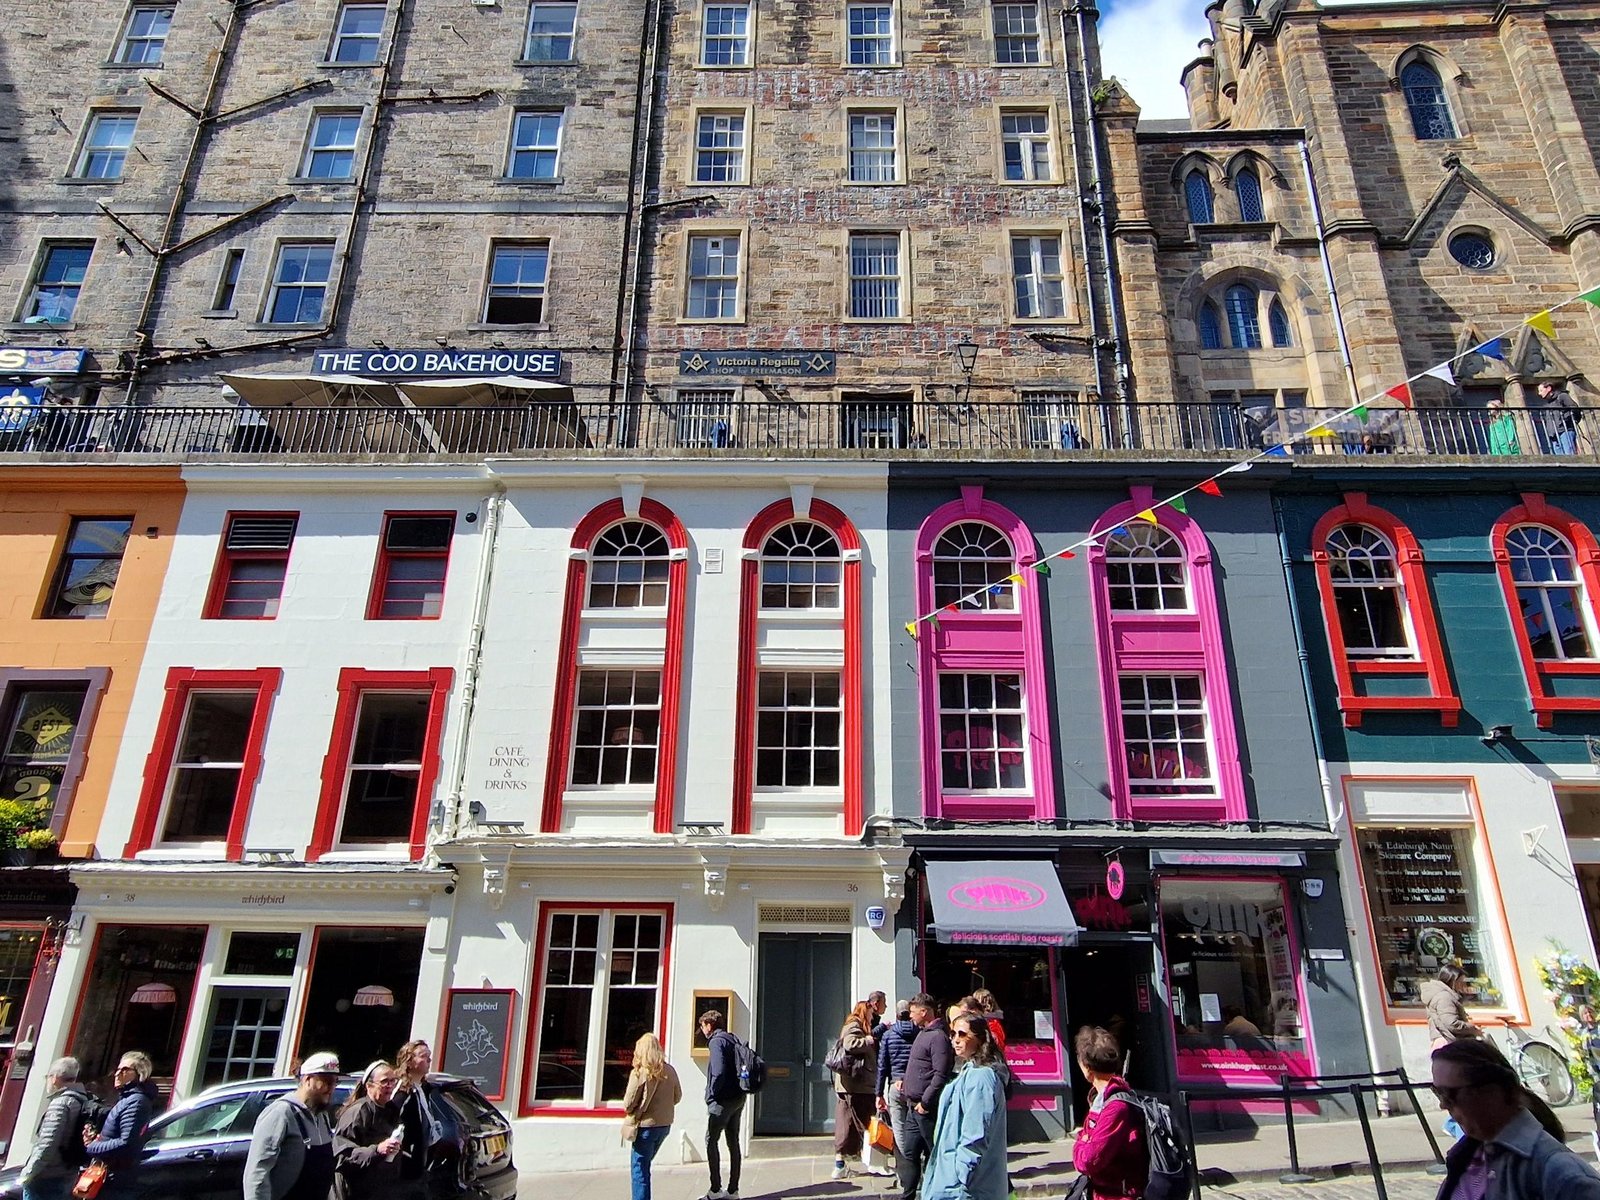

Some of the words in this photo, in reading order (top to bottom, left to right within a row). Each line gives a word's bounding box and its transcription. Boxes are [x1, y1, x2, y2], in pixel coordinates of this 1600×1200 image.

[318, 353, 362, 371] THE
[366, 353, 417, 371] COO
[423, 353, 556, 372] BAKEHOUSE
[716, 357, 757, 366] Victoria
[760, 356, 800, 367] Regalia
[32, 719, 62, 732] BEST
[489, 757, 530, 767] DINING
[503, 768, 512, 778] &
[485, 780, 527, 790] DRINKS
[1367, 841, 1383, 850] The
[1385, 842, 1428, 852] Edinburgh
[1379, 852, 1412, 860] Skincare
[1414, 852, 1452, 862] Company
[847, 883, 859, 892] 36
[123, 893, 136, 903] 38
[241, 894, 285, 906] whirlybird
[870, 911, 882, 919] RG
[1399, 915, 1437, 923] NATURAL
[1438, 915, 1478, 923] SKINCARE
[952, 931, 987, 940] delicious
[988, 932, 1020, 941] scottish
[1021, 933, 1037, 943] hog
[1038, 934, 1064, 943] roasts
[462, 1002, 499, 1013] whirlybird
[1201, 1061, 1288, 1072] www.oinkhogroast.co.uk
